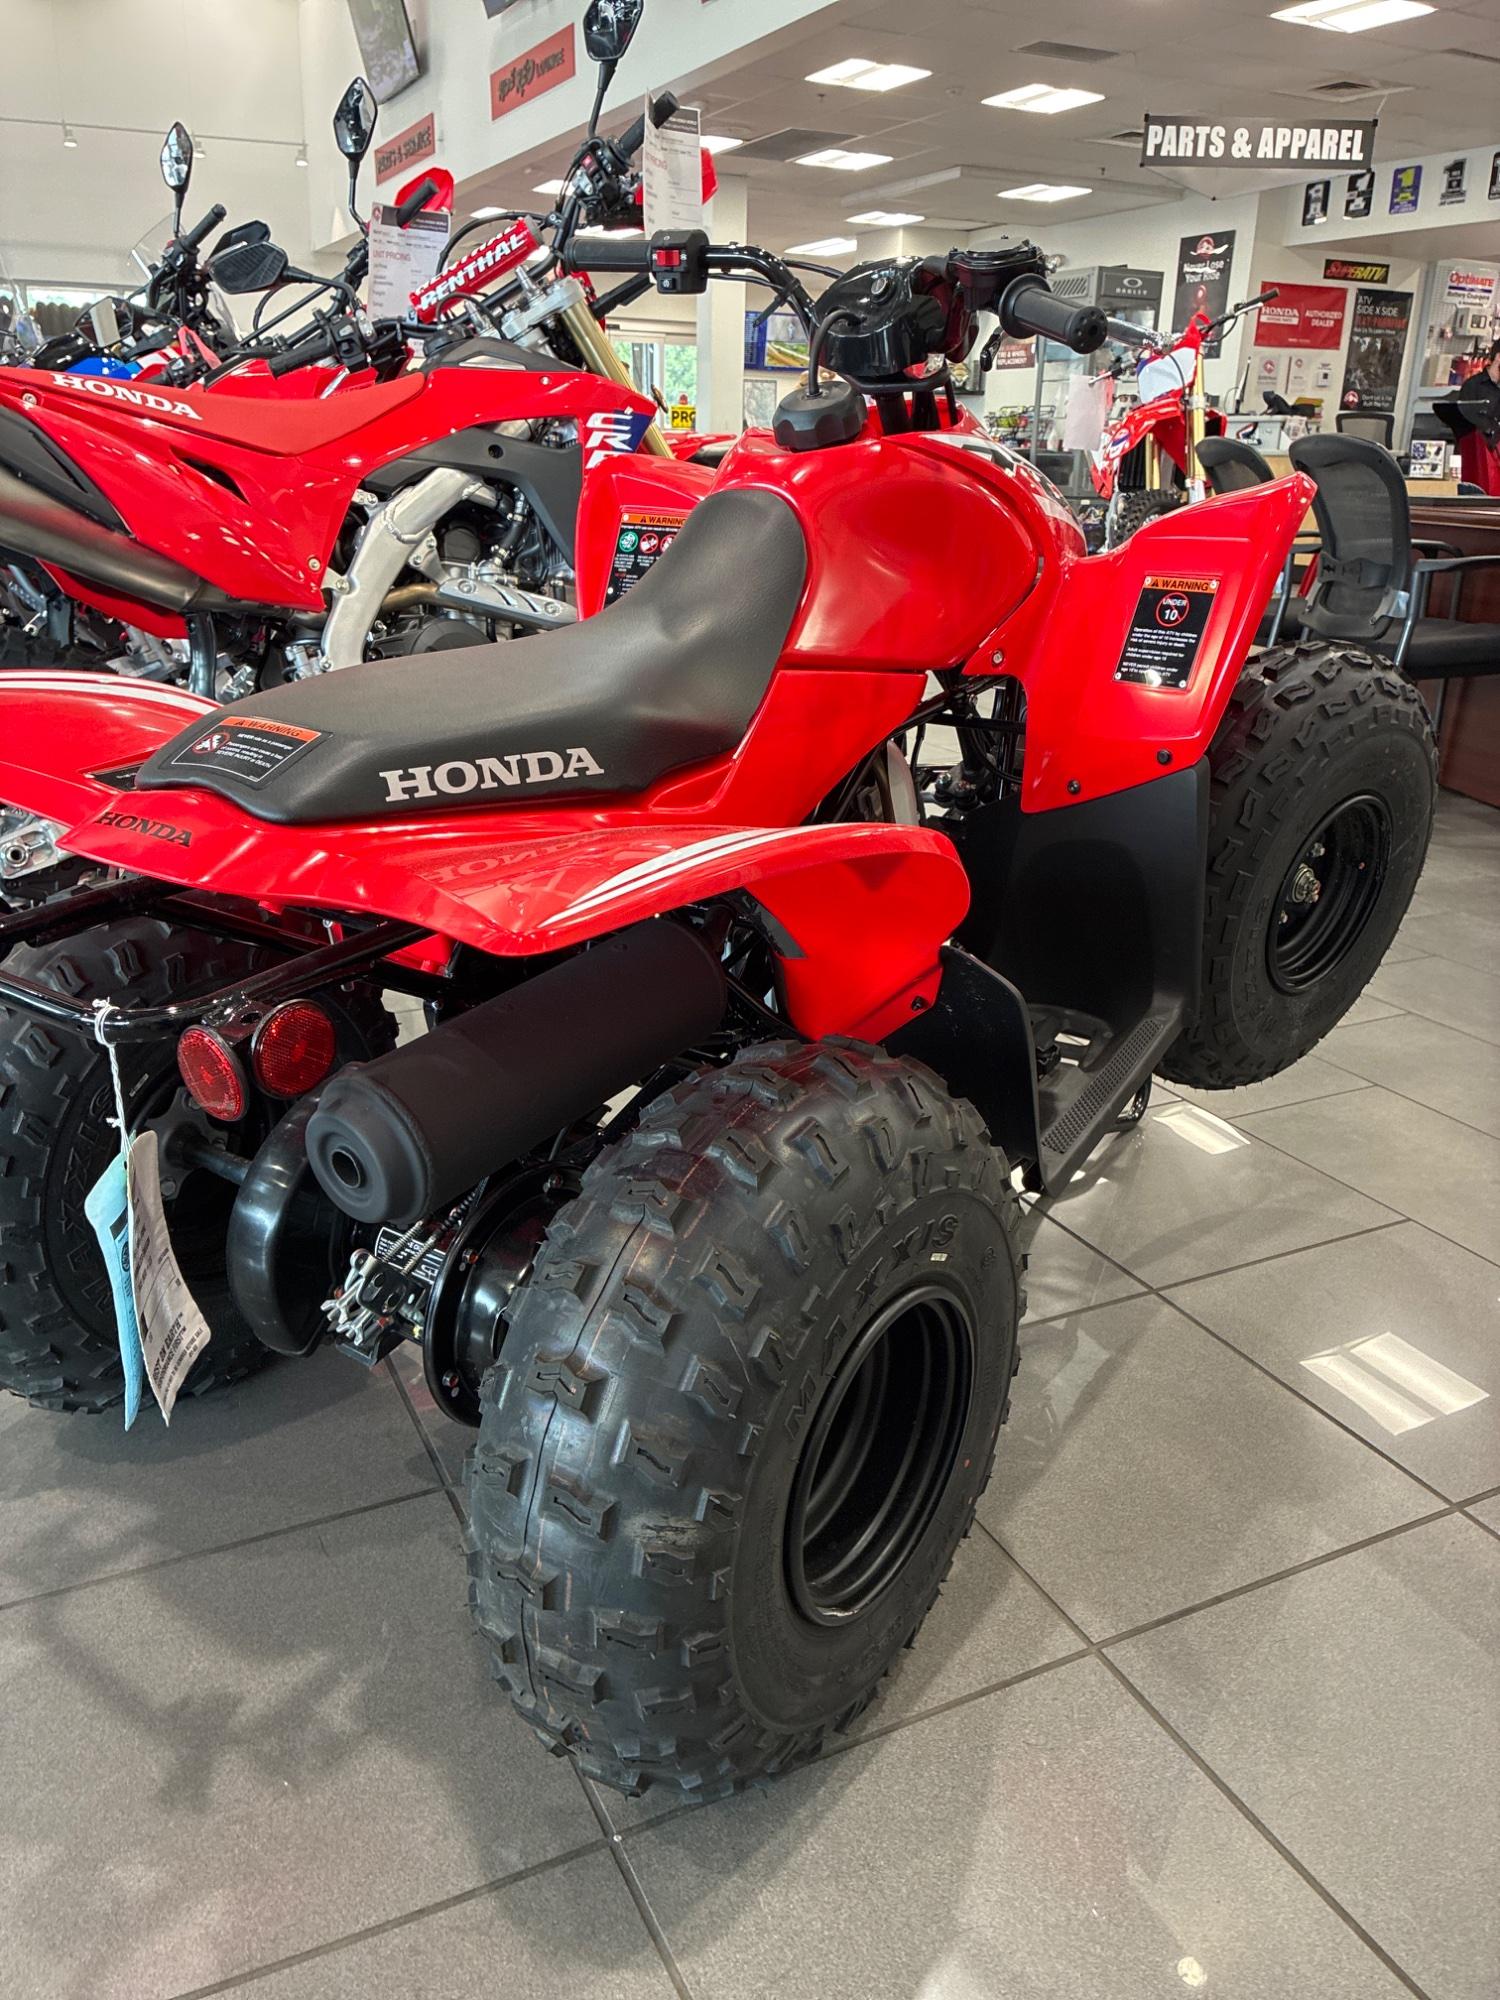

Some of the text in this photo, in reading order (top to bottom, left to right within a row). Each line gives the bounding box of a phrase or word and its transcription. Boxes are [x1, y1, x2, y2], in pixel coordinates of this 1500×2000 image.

[1146, 125, 1364, 161] PARTS & APPAREL
[420, 233, 528, 310] RENTHAL
[1358, 295, 1373, 305] ATV
[1261, 306, 1299, 317] HONDA
[1305, 309, 1343, 319] AUTHORIZED
[1356, 305, 1374, 315] SIDE
[1382, 307, 1399, 317] SIDE
[1311, 318, 1335, 328] DEALER
[50, 373, 203, 420] HONDA
[1162, 580, 1209, 591] WARNING
[1162, 598, 1188, 606] UNDER
[1164, 609, 1179, 620] 10
[249, 720, 302, 738] WARNING
[379, 748, 604, 802] HONDA
[93, 811, 193, 847] HONDA
[783, 1213, 960, 1440] MAXXIS
